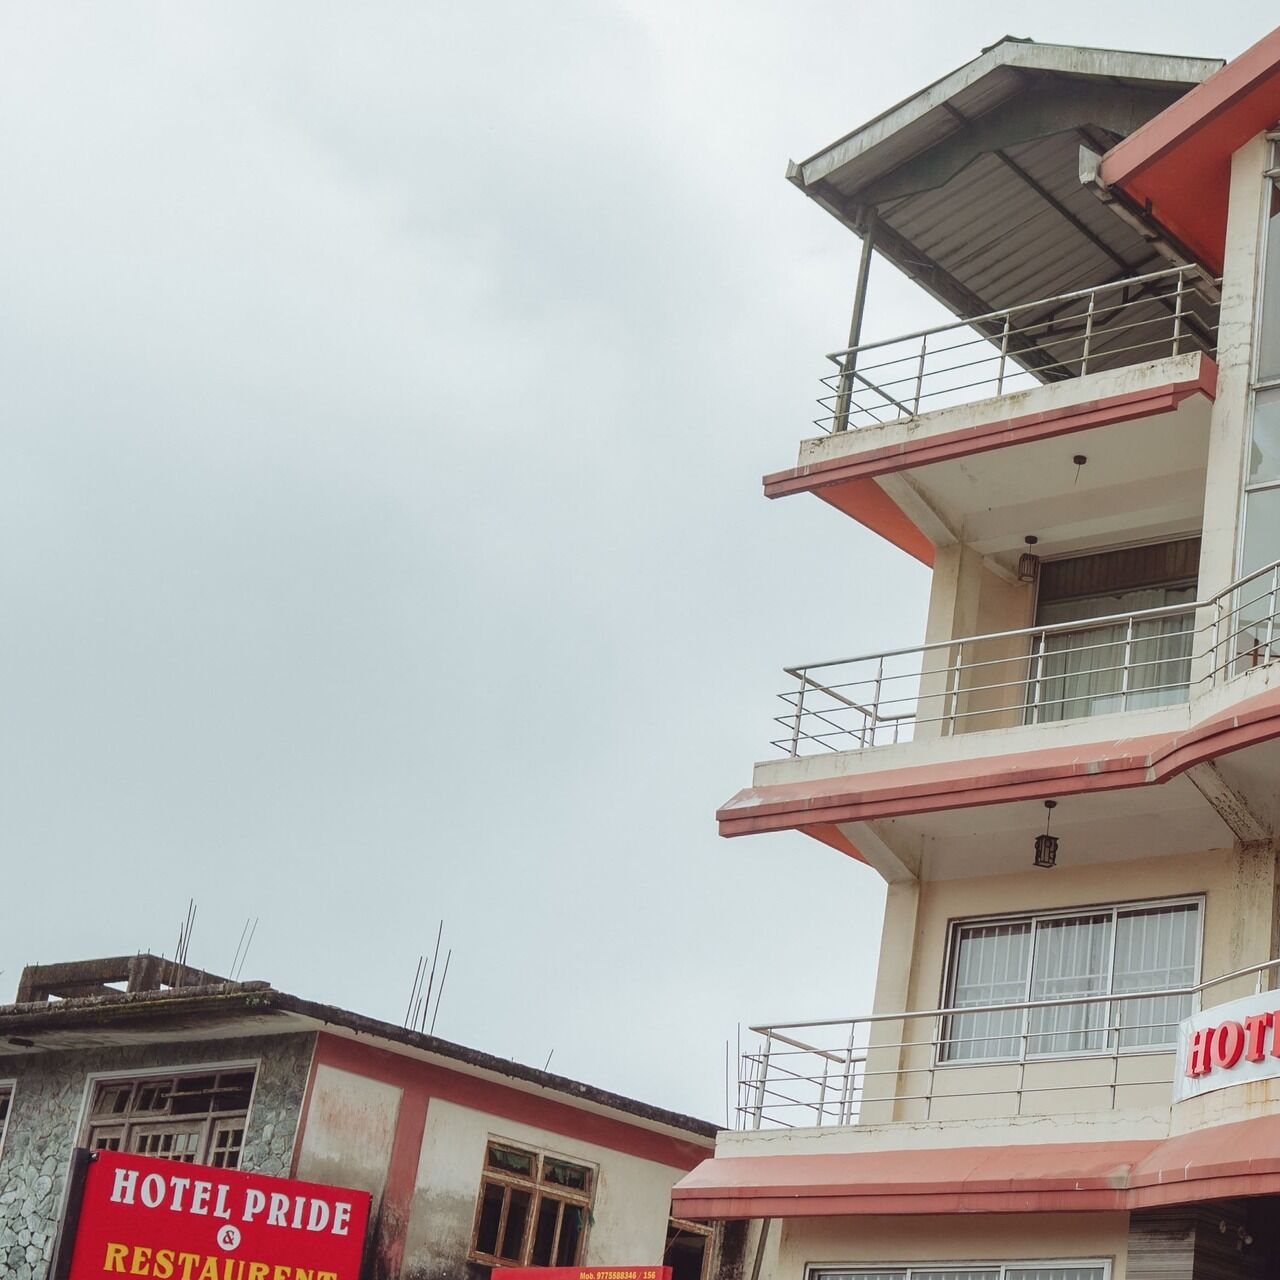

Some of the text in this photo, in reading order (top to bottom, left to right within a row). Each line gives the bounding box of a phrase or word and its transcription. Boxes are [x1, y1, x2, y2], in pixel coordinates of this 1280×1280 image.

[110, 1168, 352, 1236] HOTEL PRIDE
[222, 1229, 236, 1246] &
[579, 1271, 596, 1280] Mob.
[642, 1271, 656, 1280] 156
